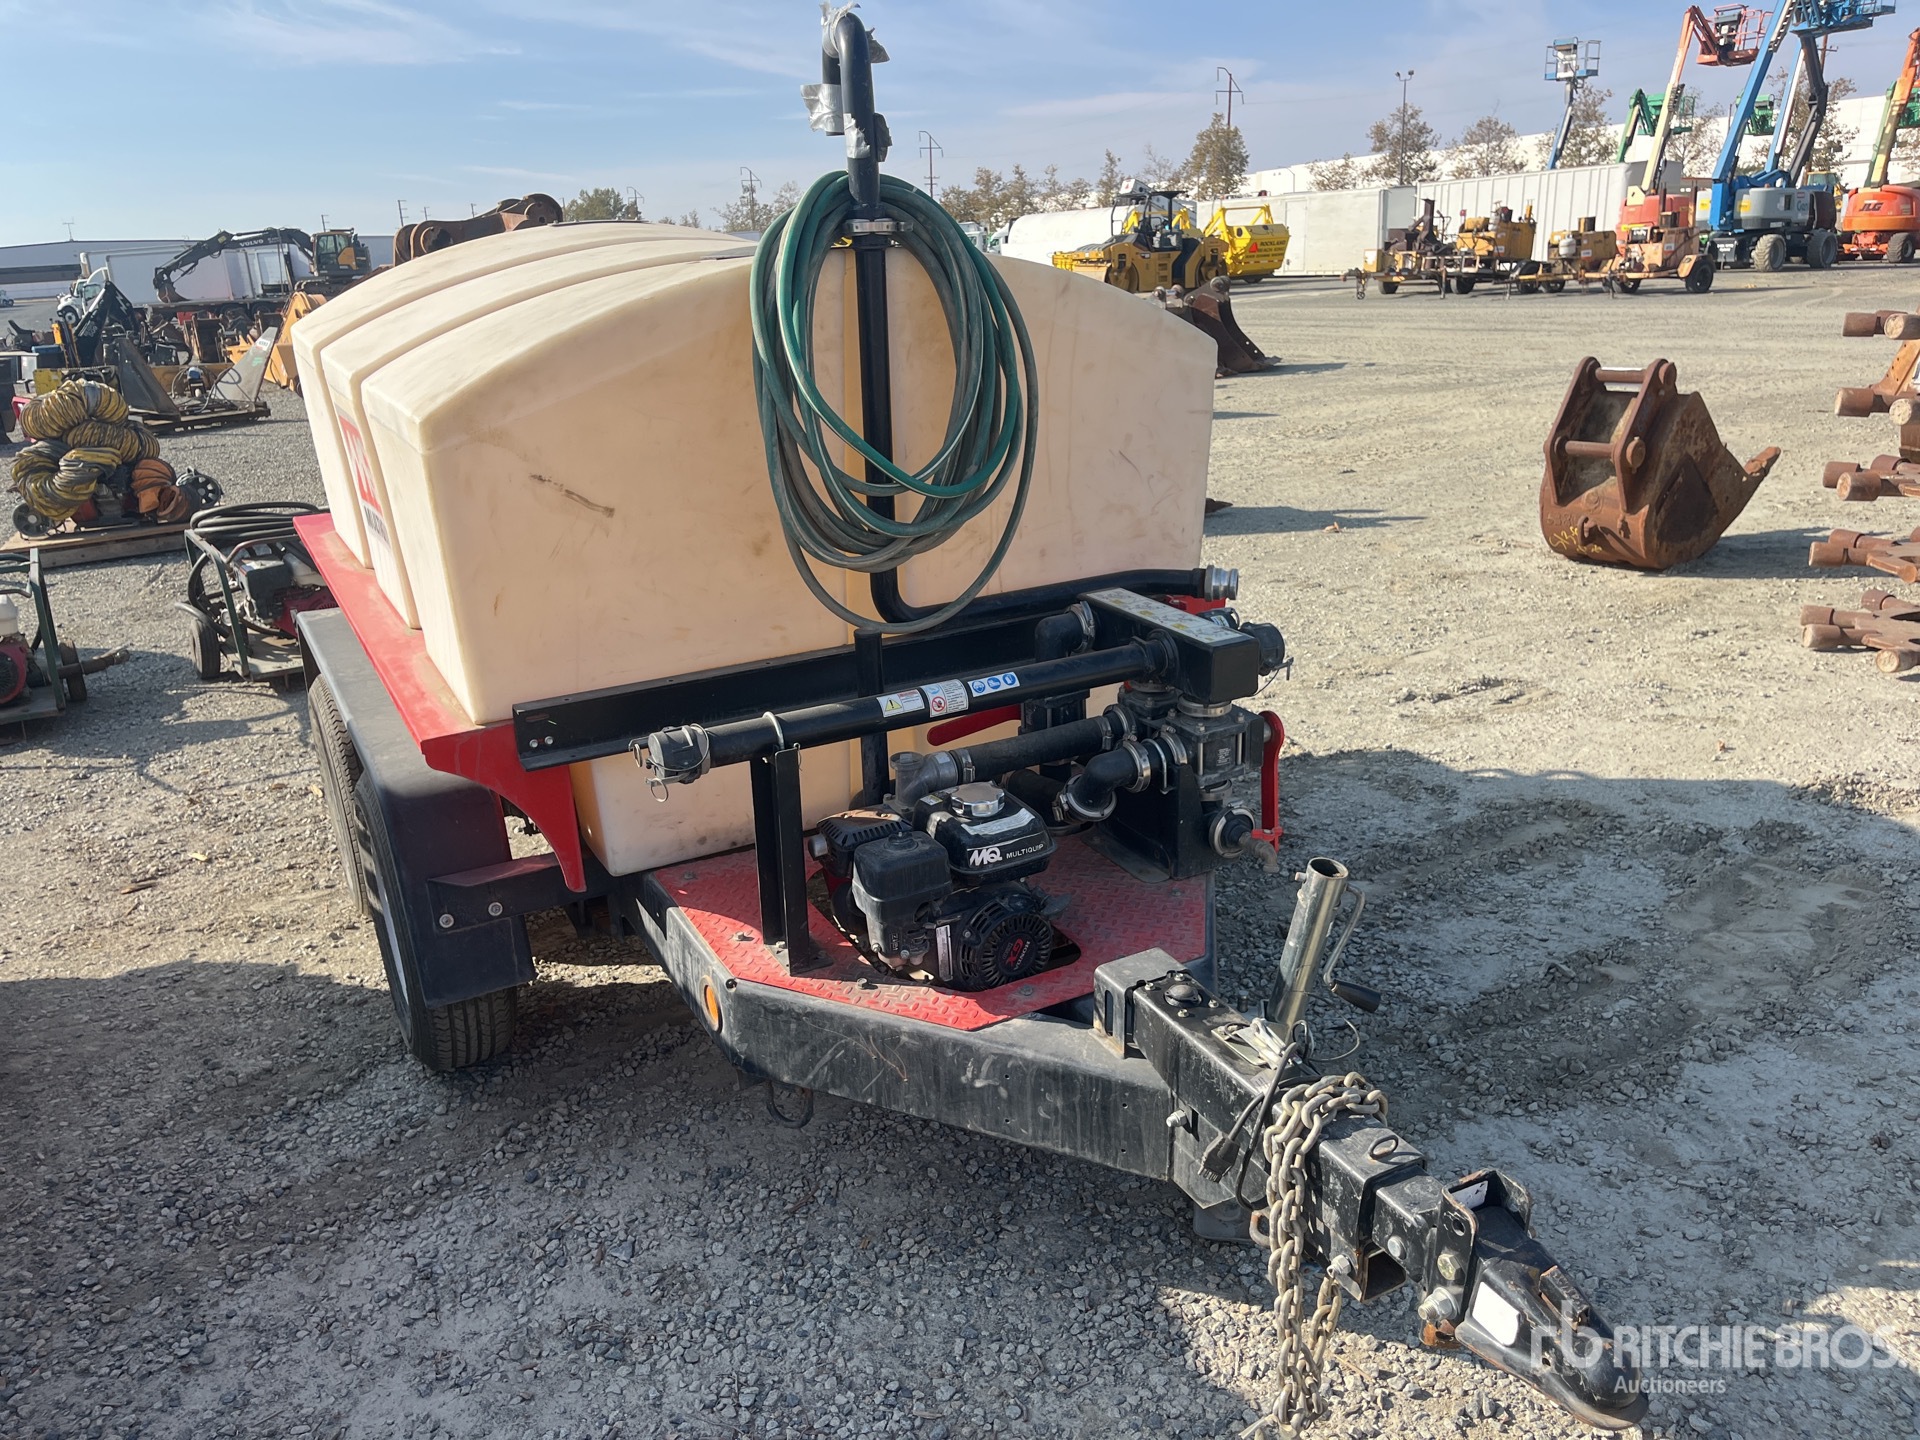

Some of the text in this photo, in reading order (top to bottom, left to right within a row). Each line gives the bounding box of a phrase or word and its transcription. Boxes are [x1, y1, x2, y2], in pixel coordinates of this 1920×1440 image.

[1858, 203, 1883, 212] JLG
[239, 238, 264, 248] VOLVO
[969, 843, 1044, 866] MQ MULTIQUIP
[1005, 938, 1024, 967] GX
[1013, 940, 1031, 971] HONDA
